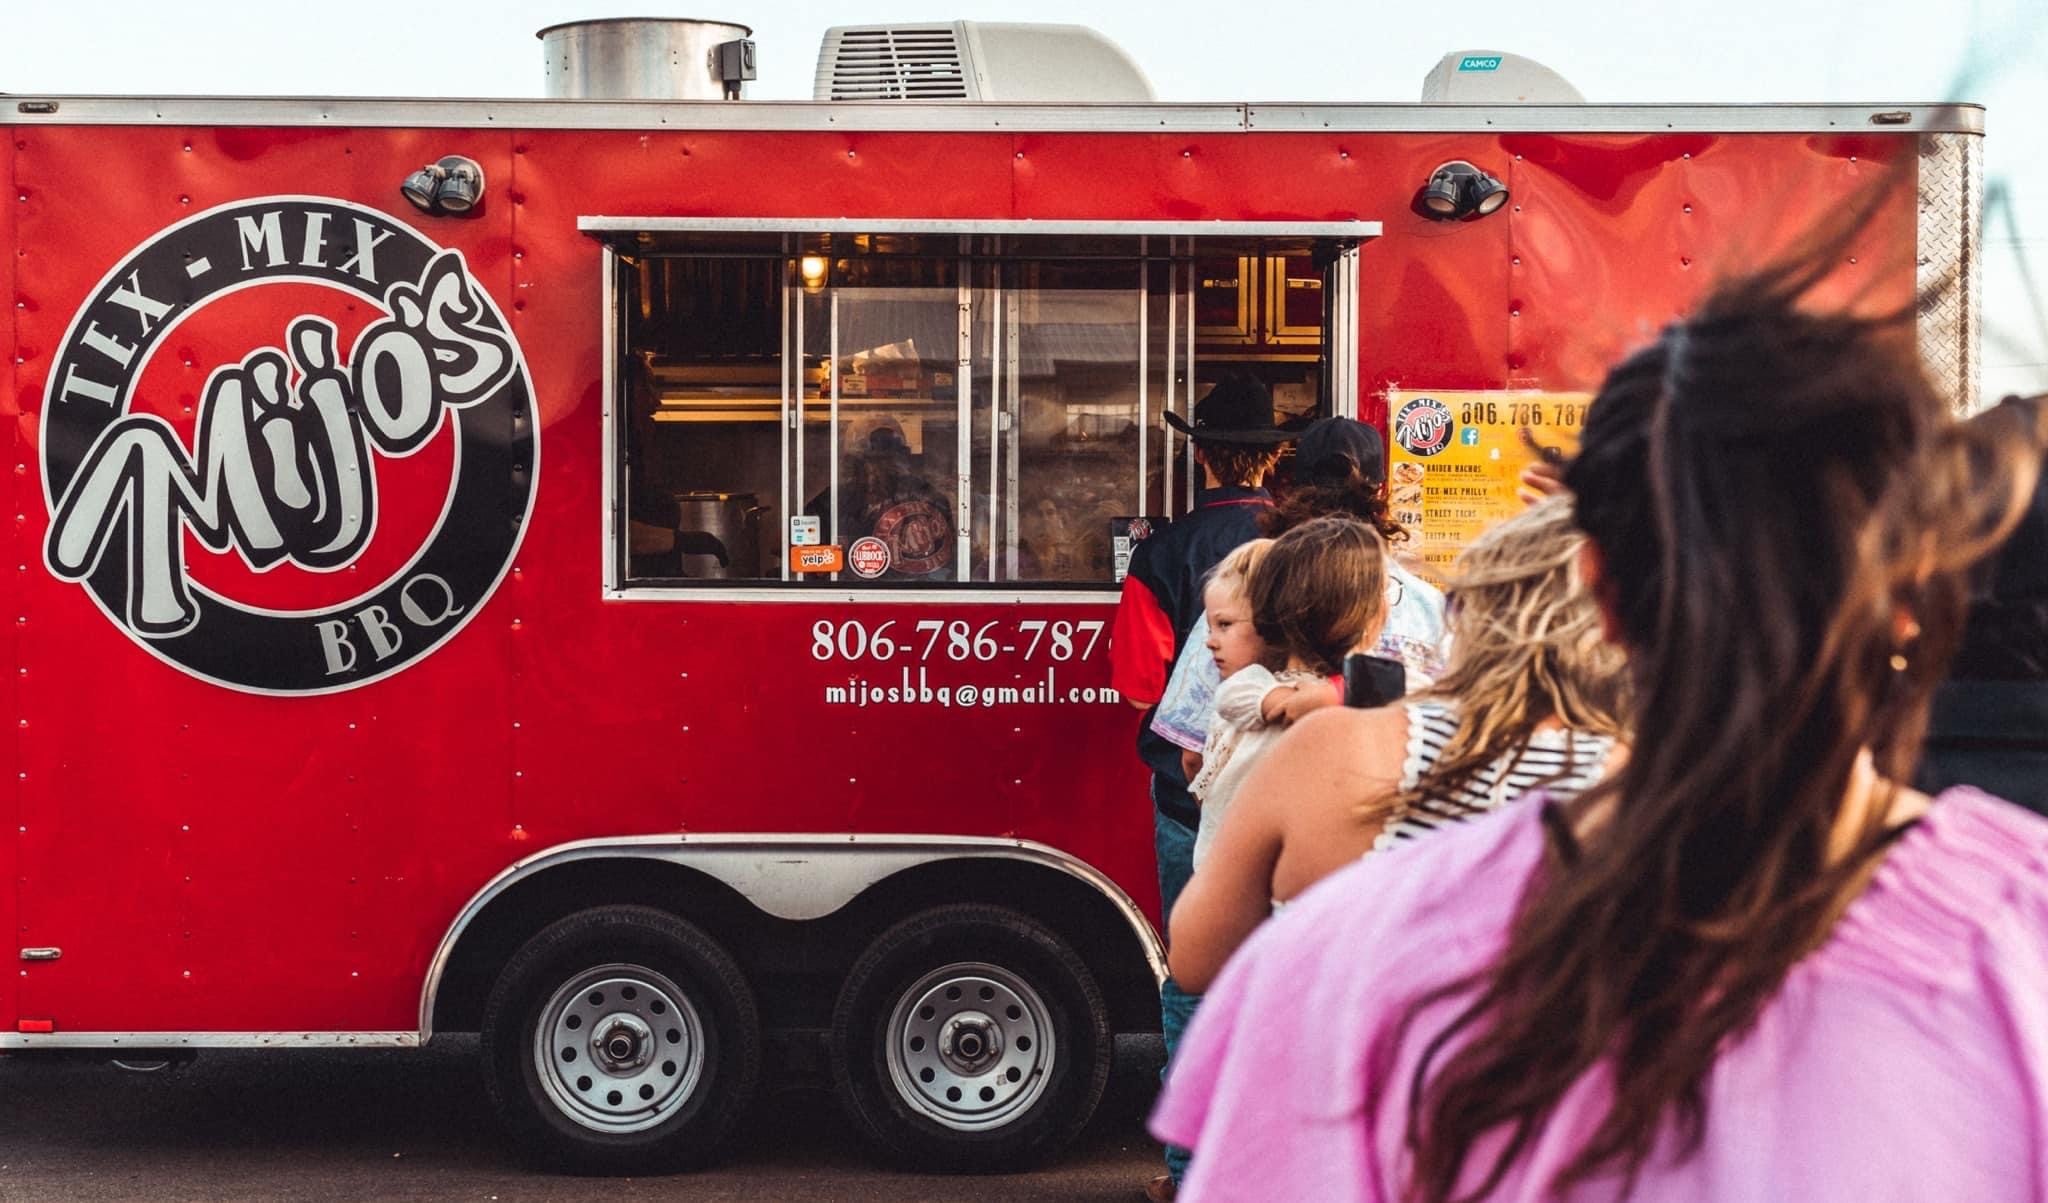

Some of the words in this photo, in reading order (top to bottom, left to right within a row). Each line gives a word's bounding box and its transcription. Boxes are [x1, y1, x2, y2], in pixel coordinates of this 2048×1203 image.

[1464, 59, 1497, 68] CAMCO
[60, 268, 175, 409] TEX
[234, 210, 397, 286] MEX
[49, 252, 514, 635] Mijo's
[1461, 487, 1487, 496] PHILLY
[1425, 509, 1451, 518] STREET
[802, 555, 824, 565] yelp
[315, 572, 465, 676] BBQ
[811, 619, 1112, 661] 806-786-787
[825, 666, 1120, 707] mijosbbq@gmail.com
